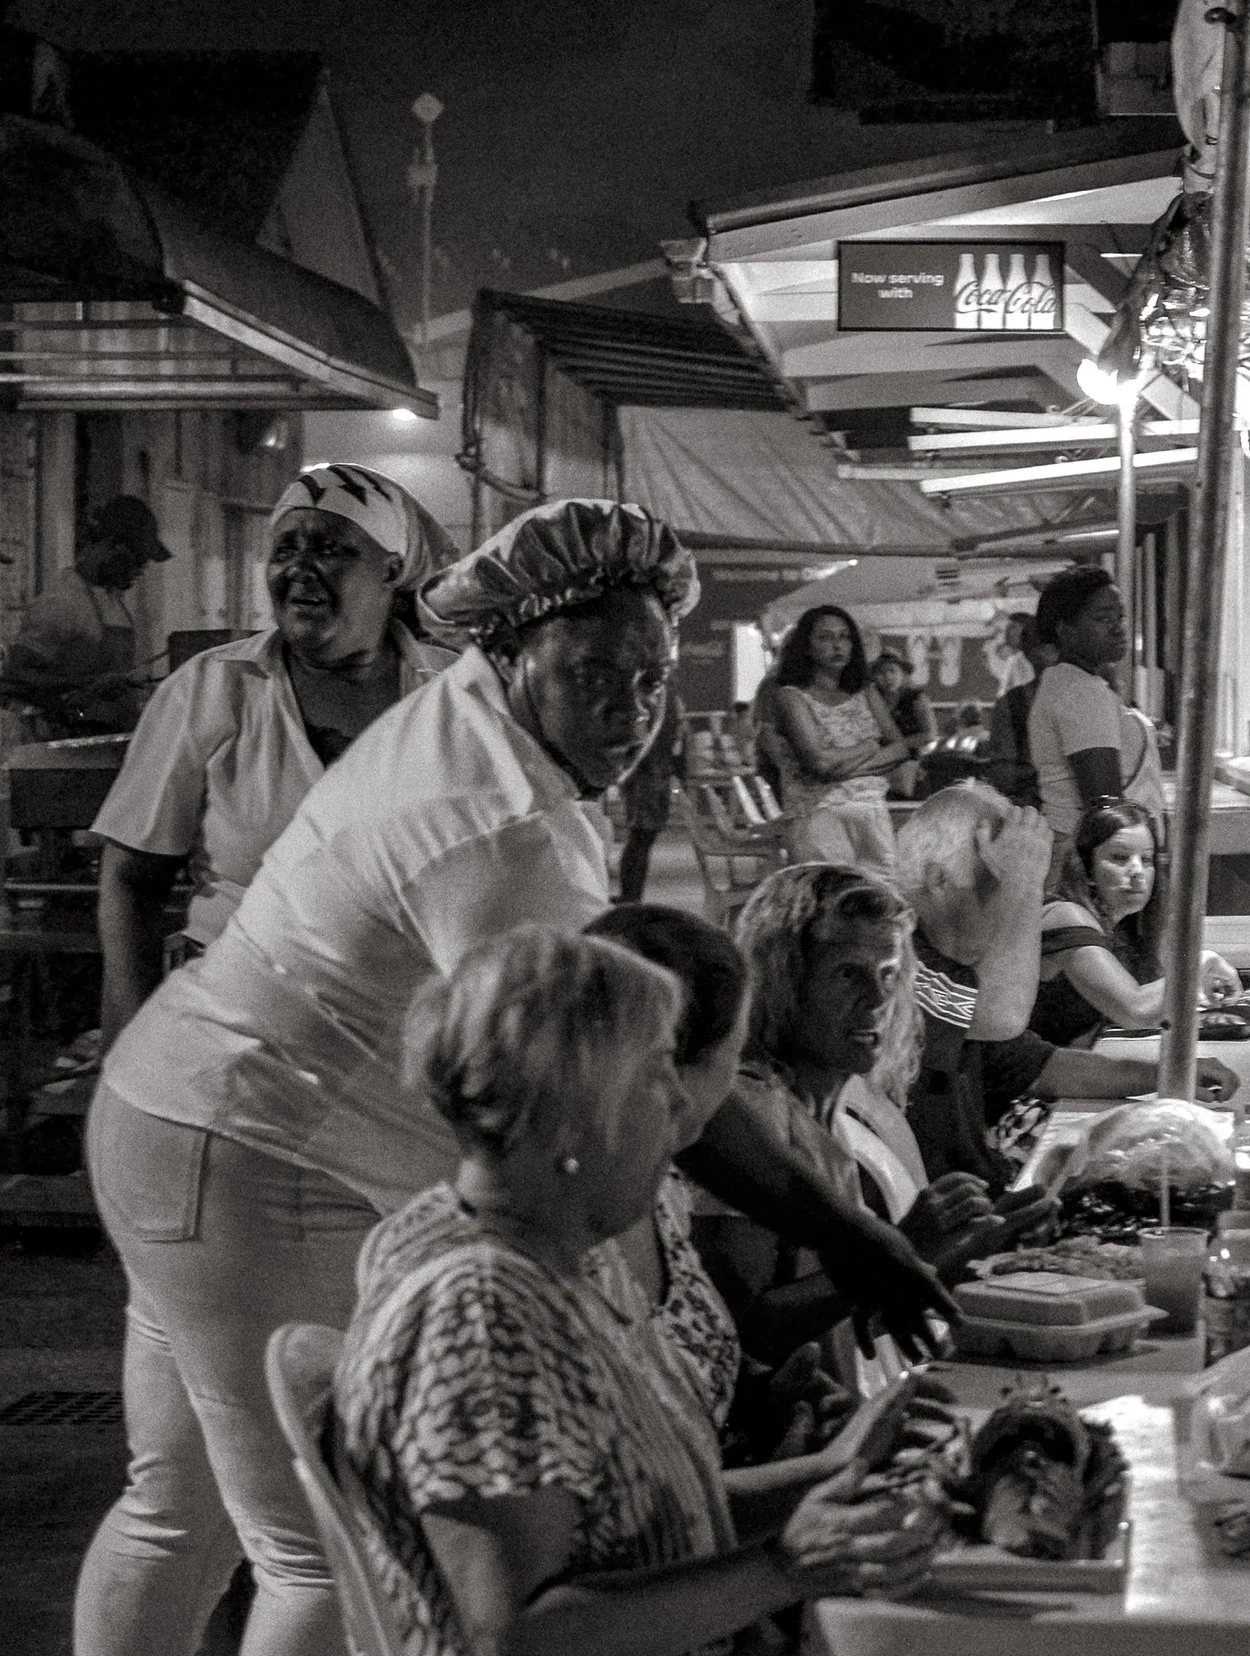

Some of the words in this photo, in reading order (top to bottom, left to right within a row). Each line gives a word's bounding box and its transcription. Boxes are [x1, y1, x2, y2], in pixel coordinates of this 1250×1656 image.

[851, 271, 887, 285] Now
[889, 271, 945, 286] serving
[877, 286, 914, 299] with
